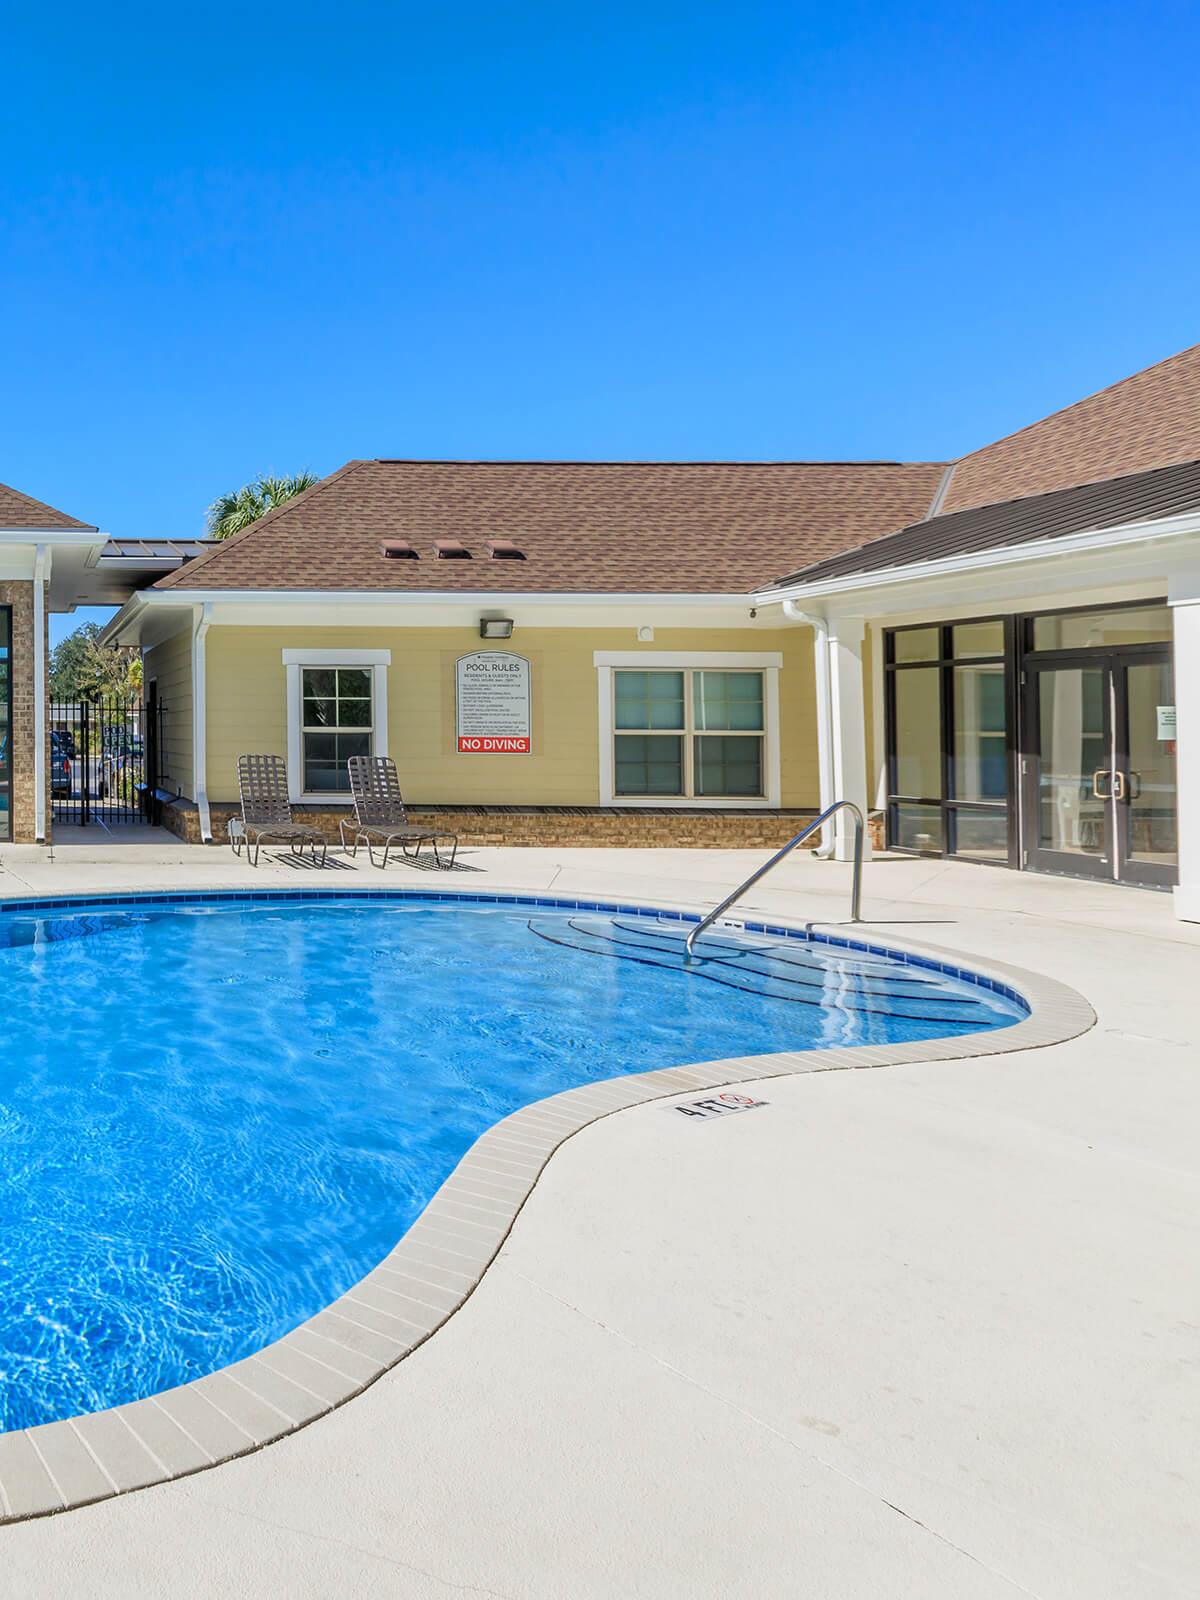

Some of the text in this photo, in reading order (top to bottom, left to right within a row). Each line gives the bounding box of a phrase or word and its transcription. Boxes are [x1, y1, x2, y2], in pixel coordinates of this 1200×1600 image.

[466, 663, 520, 672] POOL RULES
[462, 739, 526, 750] NO DIVING
[675, 1106, 707, 1117] 4
